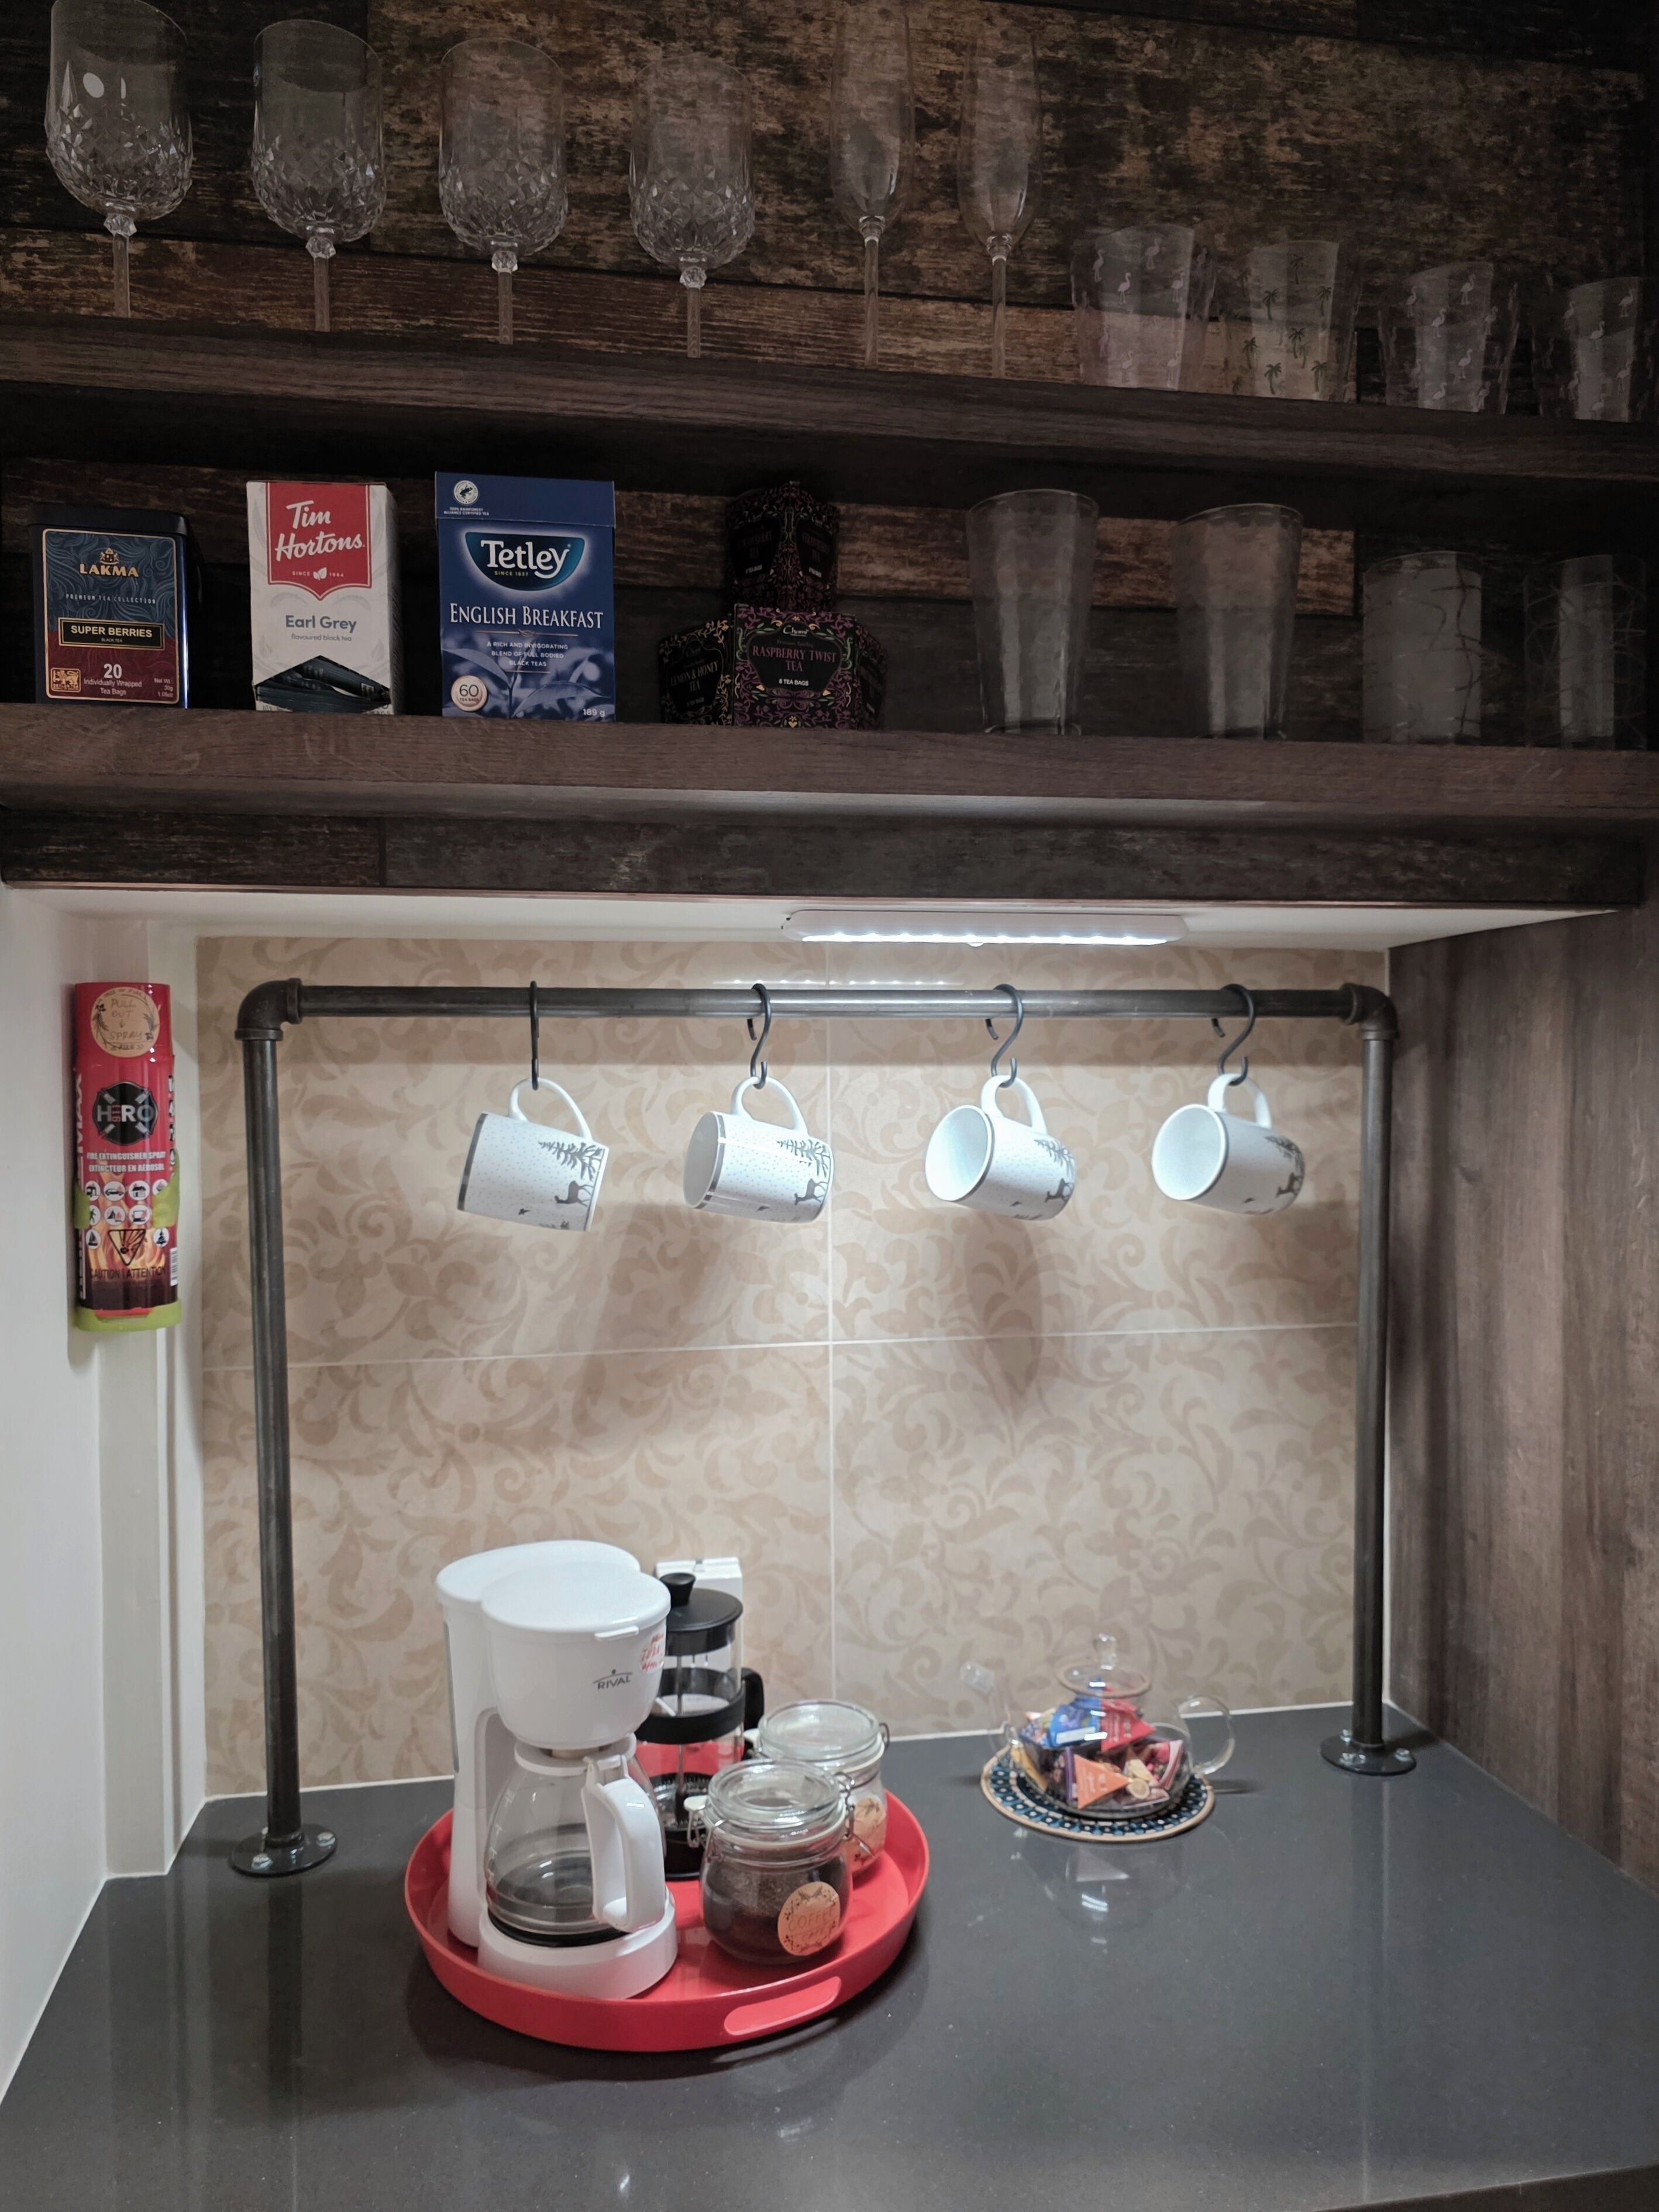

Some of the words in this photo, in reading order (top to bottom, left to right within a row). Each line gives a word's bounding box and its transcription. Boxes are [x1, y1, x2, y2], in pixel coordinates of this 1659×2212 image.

[286, 500, 331, 529] Tim
[275, 531, 363, 562] Hortons
[480, 540, 570, 579] Tetley
[80, 563, 139, 577] LAKMA
[66, 593, 96, 601] PREMIUM
[113, 597, 156, 605] COLLECTION
[450, 603, 516, 625] ENGLISH
[522, 605, 604, 629] BREAKFAST
[285, 615, 315, 629] Earl
[320, 616, 357, 633] Grey
[71, 625, 106, 636] SUPER
[108, 627, 153, 638] BERRIES
[291, 633, 322, 642] flavoured
[752, 645, 805, 660] RASPBERRY
[810, 650, 837, 663] TWIST
[104, 663, 122, 679] 20
[786, 660, 803, 672] TEA
[84, 678, 115, 687] Individually
[116, 680, 143, 688] Wrapped
[112, 688, 127, 697] Bags
[459, 684, 479, 697] 60
[583, 708, 597, 716] 189
[89, 1164, 126, 1173] EXTINCTEUR
[90, 1269, 119, 1279] CAUTION
[126, 1266, 166, 1279] ATTENTION
[597, 1674, 631, 1690] RIVAL
